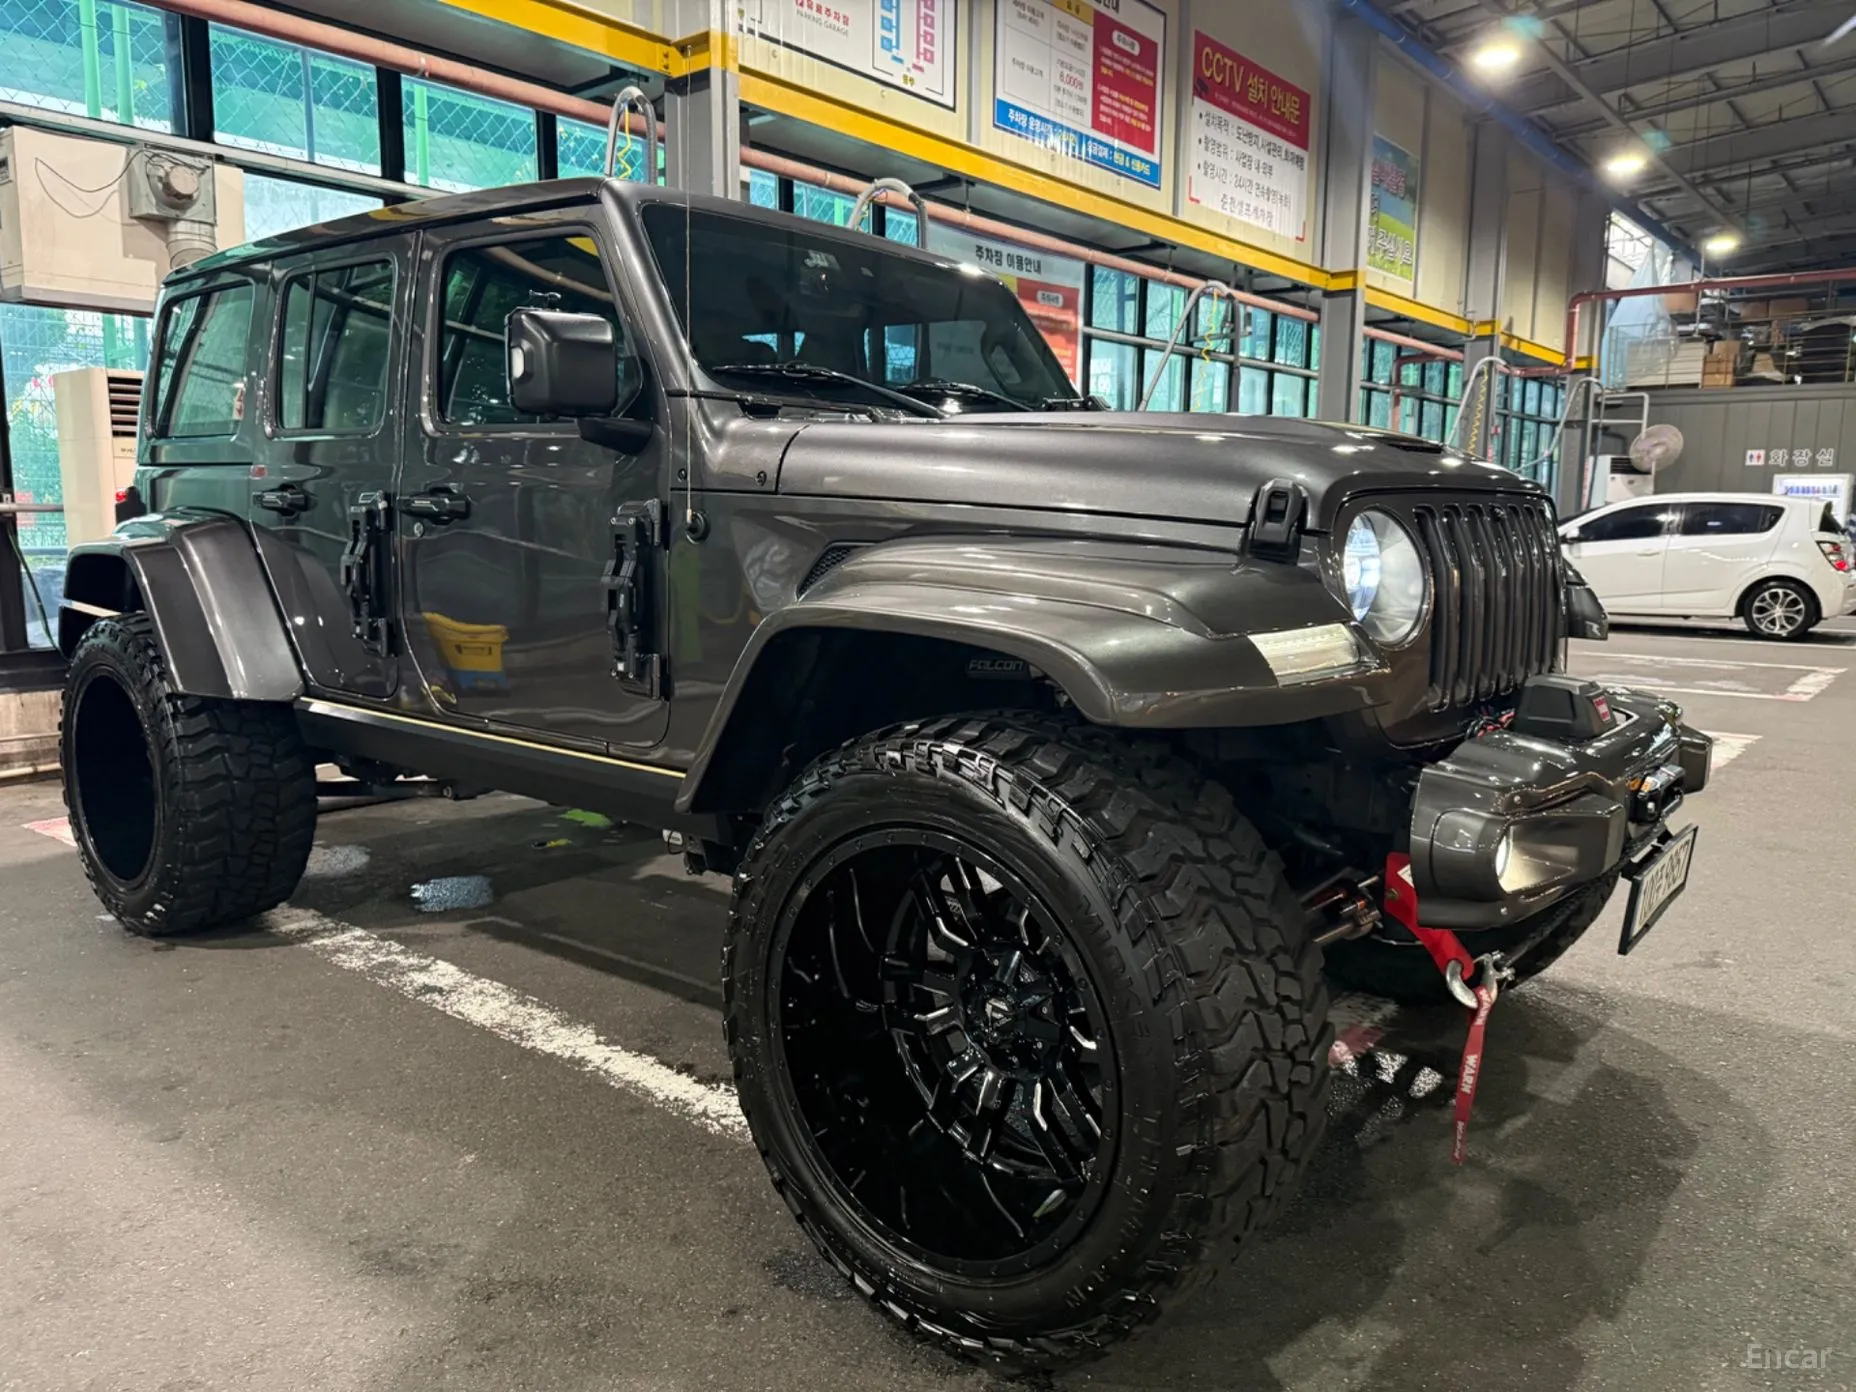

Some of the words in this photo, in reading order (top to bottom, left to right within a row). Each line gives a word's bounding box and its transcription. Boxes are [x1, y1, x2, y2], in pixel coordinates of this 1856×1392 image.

[824, 20, 849, 37] GARAGE
[1202, 47, 1244, 92] CCTV
[1247, 72, 1268, 107] 설치
[1271, 87, 1300, 125] 안내문
[976, 245, 1003, 267] 주차장
[1006, 253, 1042, 275] 이용안내
[1769, 448, 1834, 467] 화장실
[968, 659, 1023, 671] FALCON
[1460, 1054, 1478, 1095] WARN
